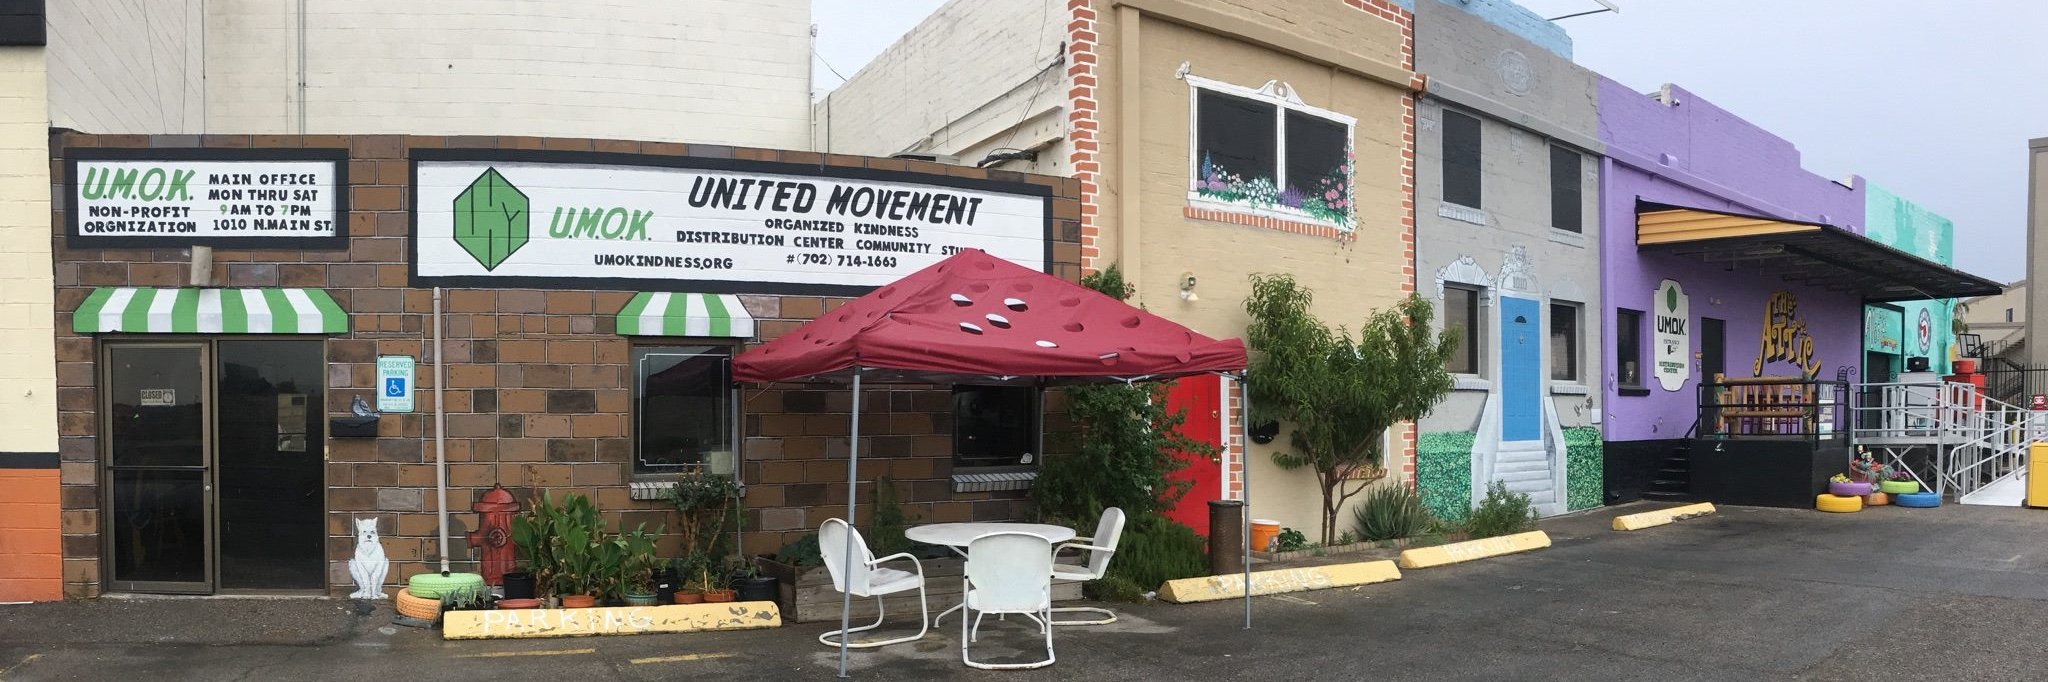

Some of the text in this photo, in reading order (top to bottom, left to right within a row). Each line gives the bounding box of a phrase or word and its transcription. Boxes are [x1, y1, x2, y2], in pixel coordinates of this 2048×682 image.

[82, 166, 196, 202] U.M.O.K.
[209, 174, 316, 185] MAIN OFFICE
[208, 189, 318, 201] MON THRU SAT
[688, 176, 982, 226] UNITED MOVEMENT
[89, 206, 190, 218] NON-PROFIT
[256, 204, 275, 216] TO
[84, 221, 196, 233] ORGNIZATION
[213, 219, 247, 230] 1010
[314, 220, 334, 231] ST.
[549, 206, 654, 241] U.M.O.K.
[765, 218, 919, 238] ORGANIZED KINDNESS
[676, 230, 784, 247] DISTRIBUTION
[794, 235, 844, 250] CENTER
[856, 239, 931, 255] COMMUNITY
[594, 254, 733, 270] UMOKINDNESS.ORG
[787, 253, 897, 268] #(702) 714-1663
[379, 360, 413, 369] RESERVED
[142, 390, 162, 400] CLOSED
[483, 607, 652, 633] PARKING
